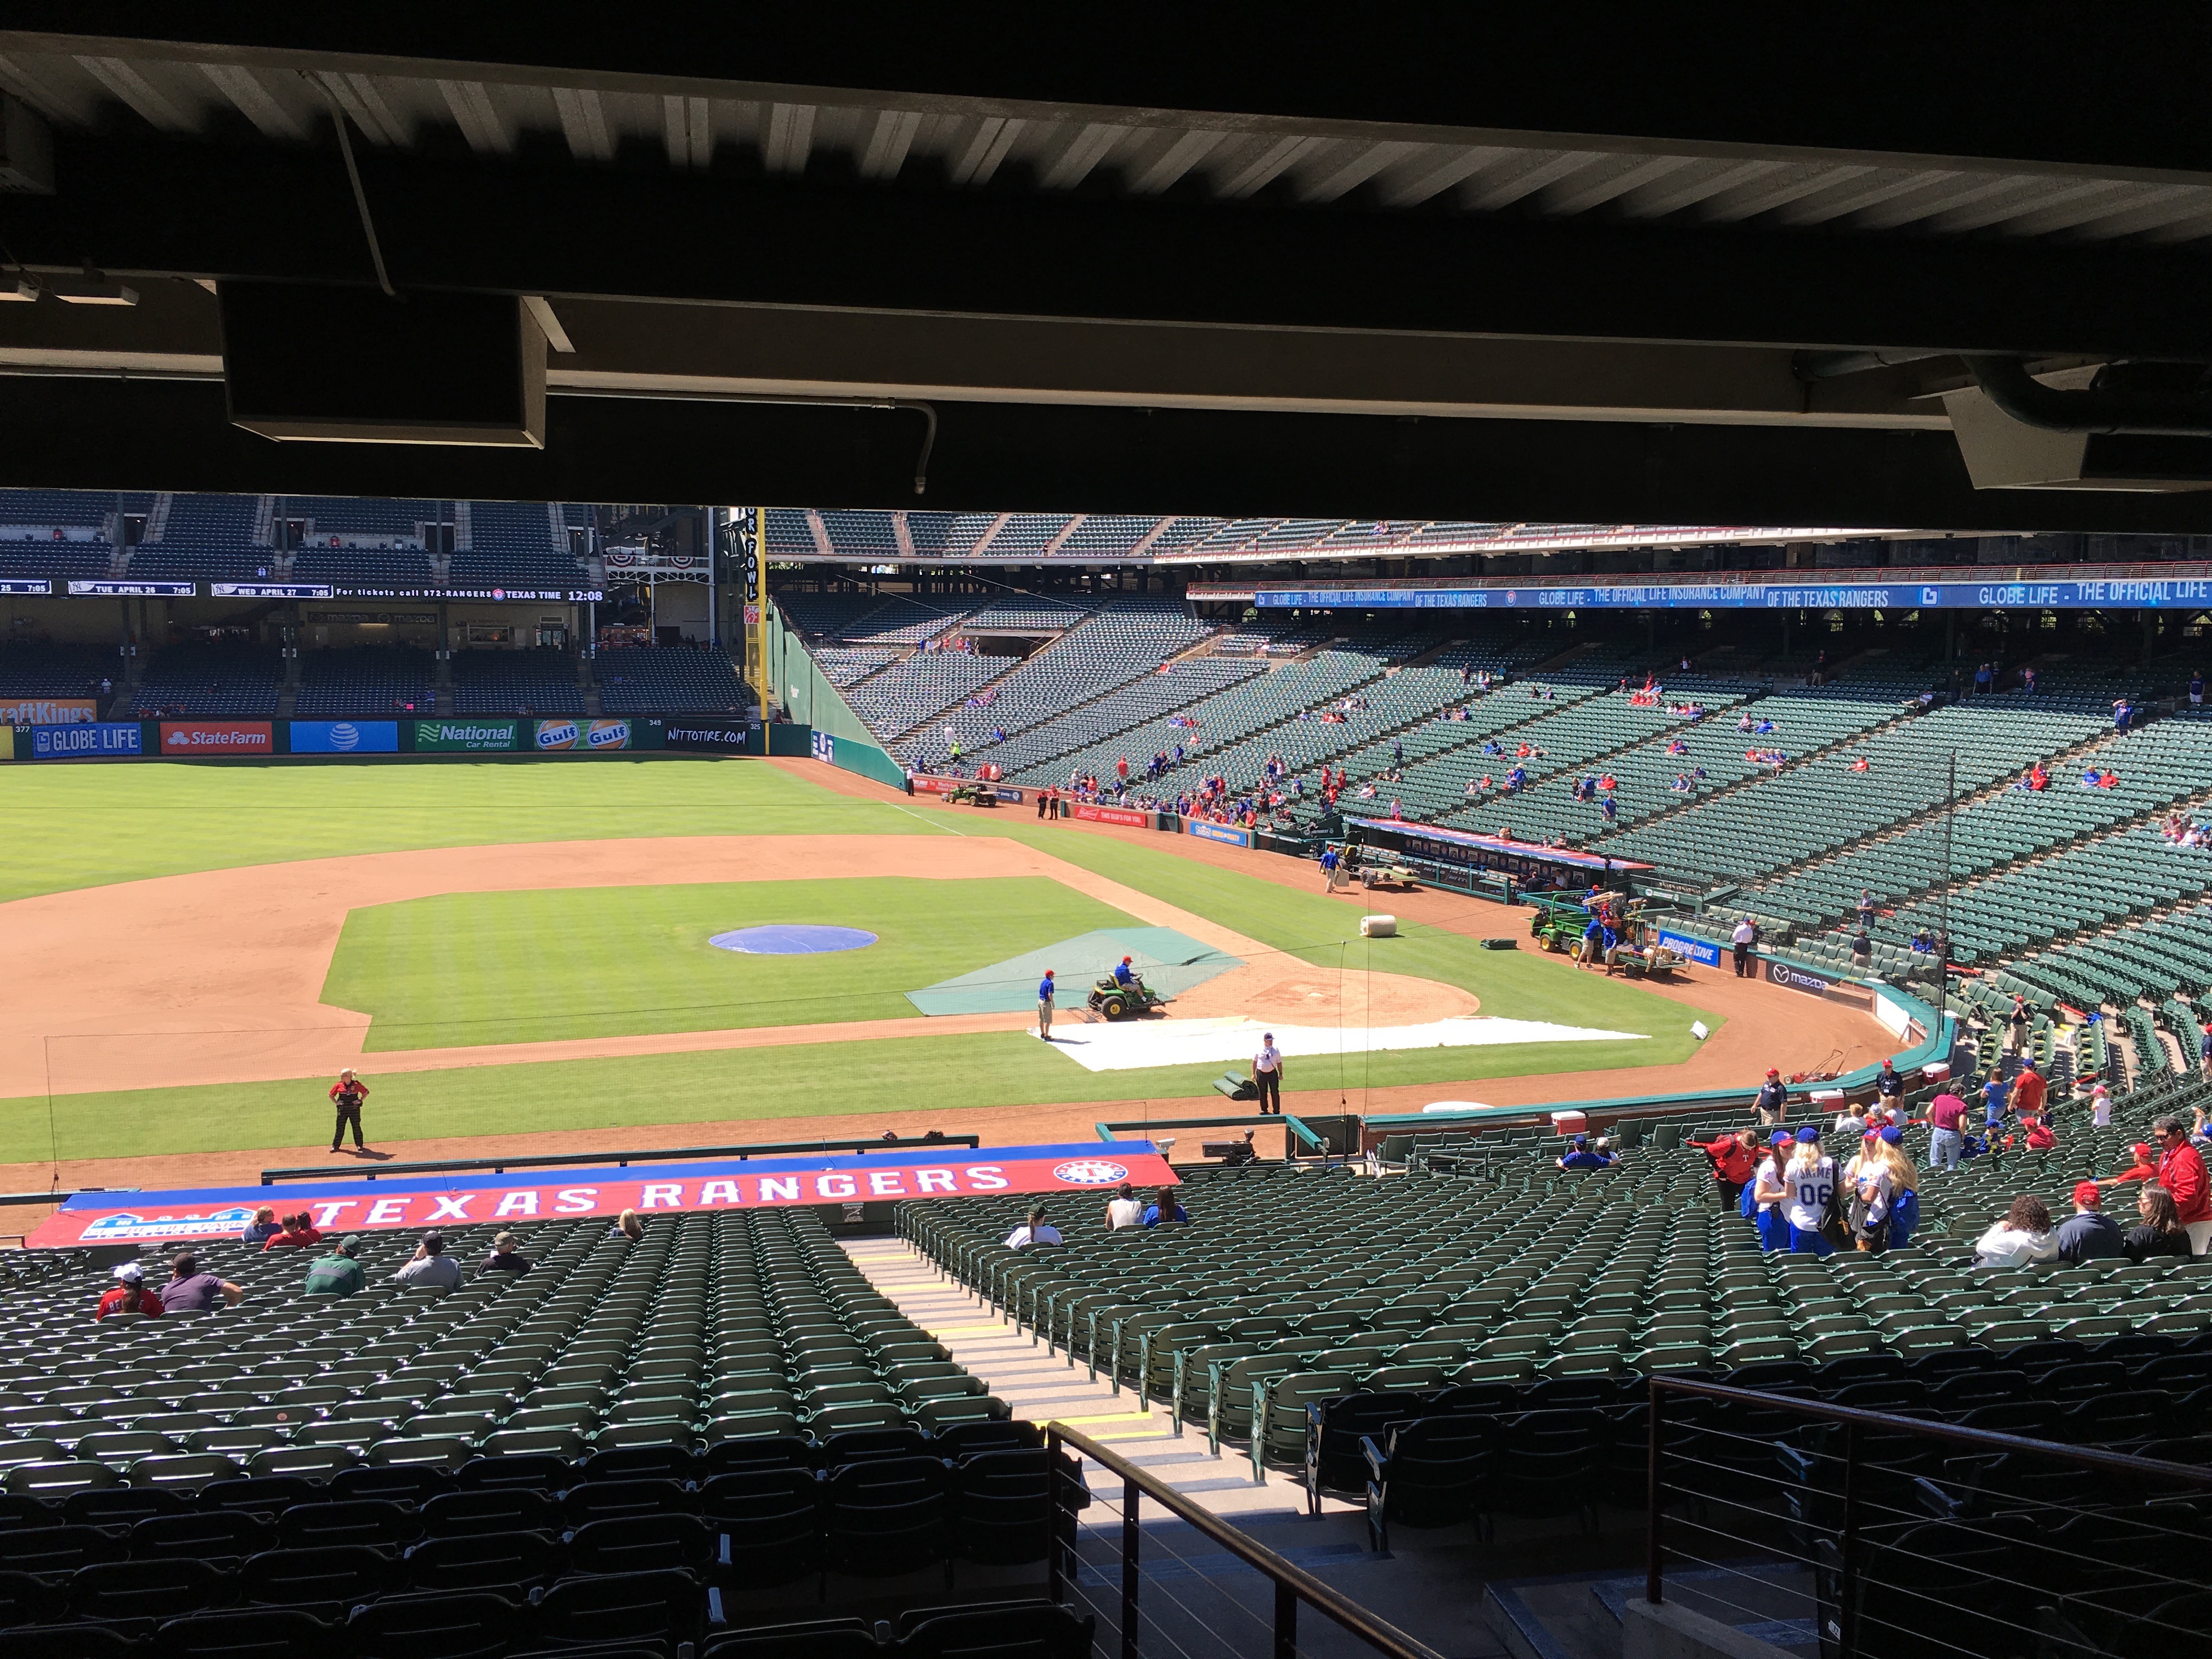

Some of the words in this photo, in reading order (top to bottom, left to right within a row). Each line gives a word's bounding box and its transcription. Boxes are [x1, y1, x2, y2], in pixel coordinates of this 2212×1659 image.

[424, 590, 492, 598] 972-RANGERS
[505, 591, 536, 599] TEXAS
[568, 591, 603, 601] 12:08
[1273, 594, 1290, 605] GLOBE
[1291, 594, 1302, 605] LIFE
[1308, 592, 1318, 602] THE
[1320, 591, 1342, 603] OFFICIAL
[1342, 592, 1354, 602] LIFE
[1355, 591, 1386, 602] INSURANCE
[1386, 591, 1414, 602] COMPANY
[1415, 594, 1423, 607] OF
[1424, 594, 1436, 607] THE
[1436, 594, 1457, 607] TEXAS
[1458, 594, 1487, 607] RANGERS
[1538, 591, 1565, 605] GLOBE
[1567, 591, 1584, 605] LIFE
[1594, 589, 1610, 602] THE
[1612, 588, 1646, 602] OFFICIAL
[1649, 588, 1666, 600] LIFE
[1668, 587, 1718, 600] INSURANCE
[1720, 587, 1766, 600] COMPANY
[1767, 591, 1780, 607] OF
[1782, 591, 1803, 607] THE
[1803, 591, 1837, 607] TEXAS
[1838, 590, 1889, 607] RANGERS
[1979, 586, 2025, 605] GLOBE
[2030, 586, 2058, 604] LIFE
[2077, 583, 2104, 600] THE
[2109, 582, 2171, 601] OFFICIAL
[2176, 582, 2207, 599] LIFE
[53, 729, 98, 751] GLOBE
[103, 729, 138, 749] LIFE
[539, 726, 575, 744] Gulf
[589, 726, 625, 744] Gulf
[668, 726, 746, 745] NITTOTIRE.COM
[311, 1188, 601, 1227] TEXAS
[640, 1166, 1011, 1208] RANGERS
[1799, 1183, 1834, 1206] 06
